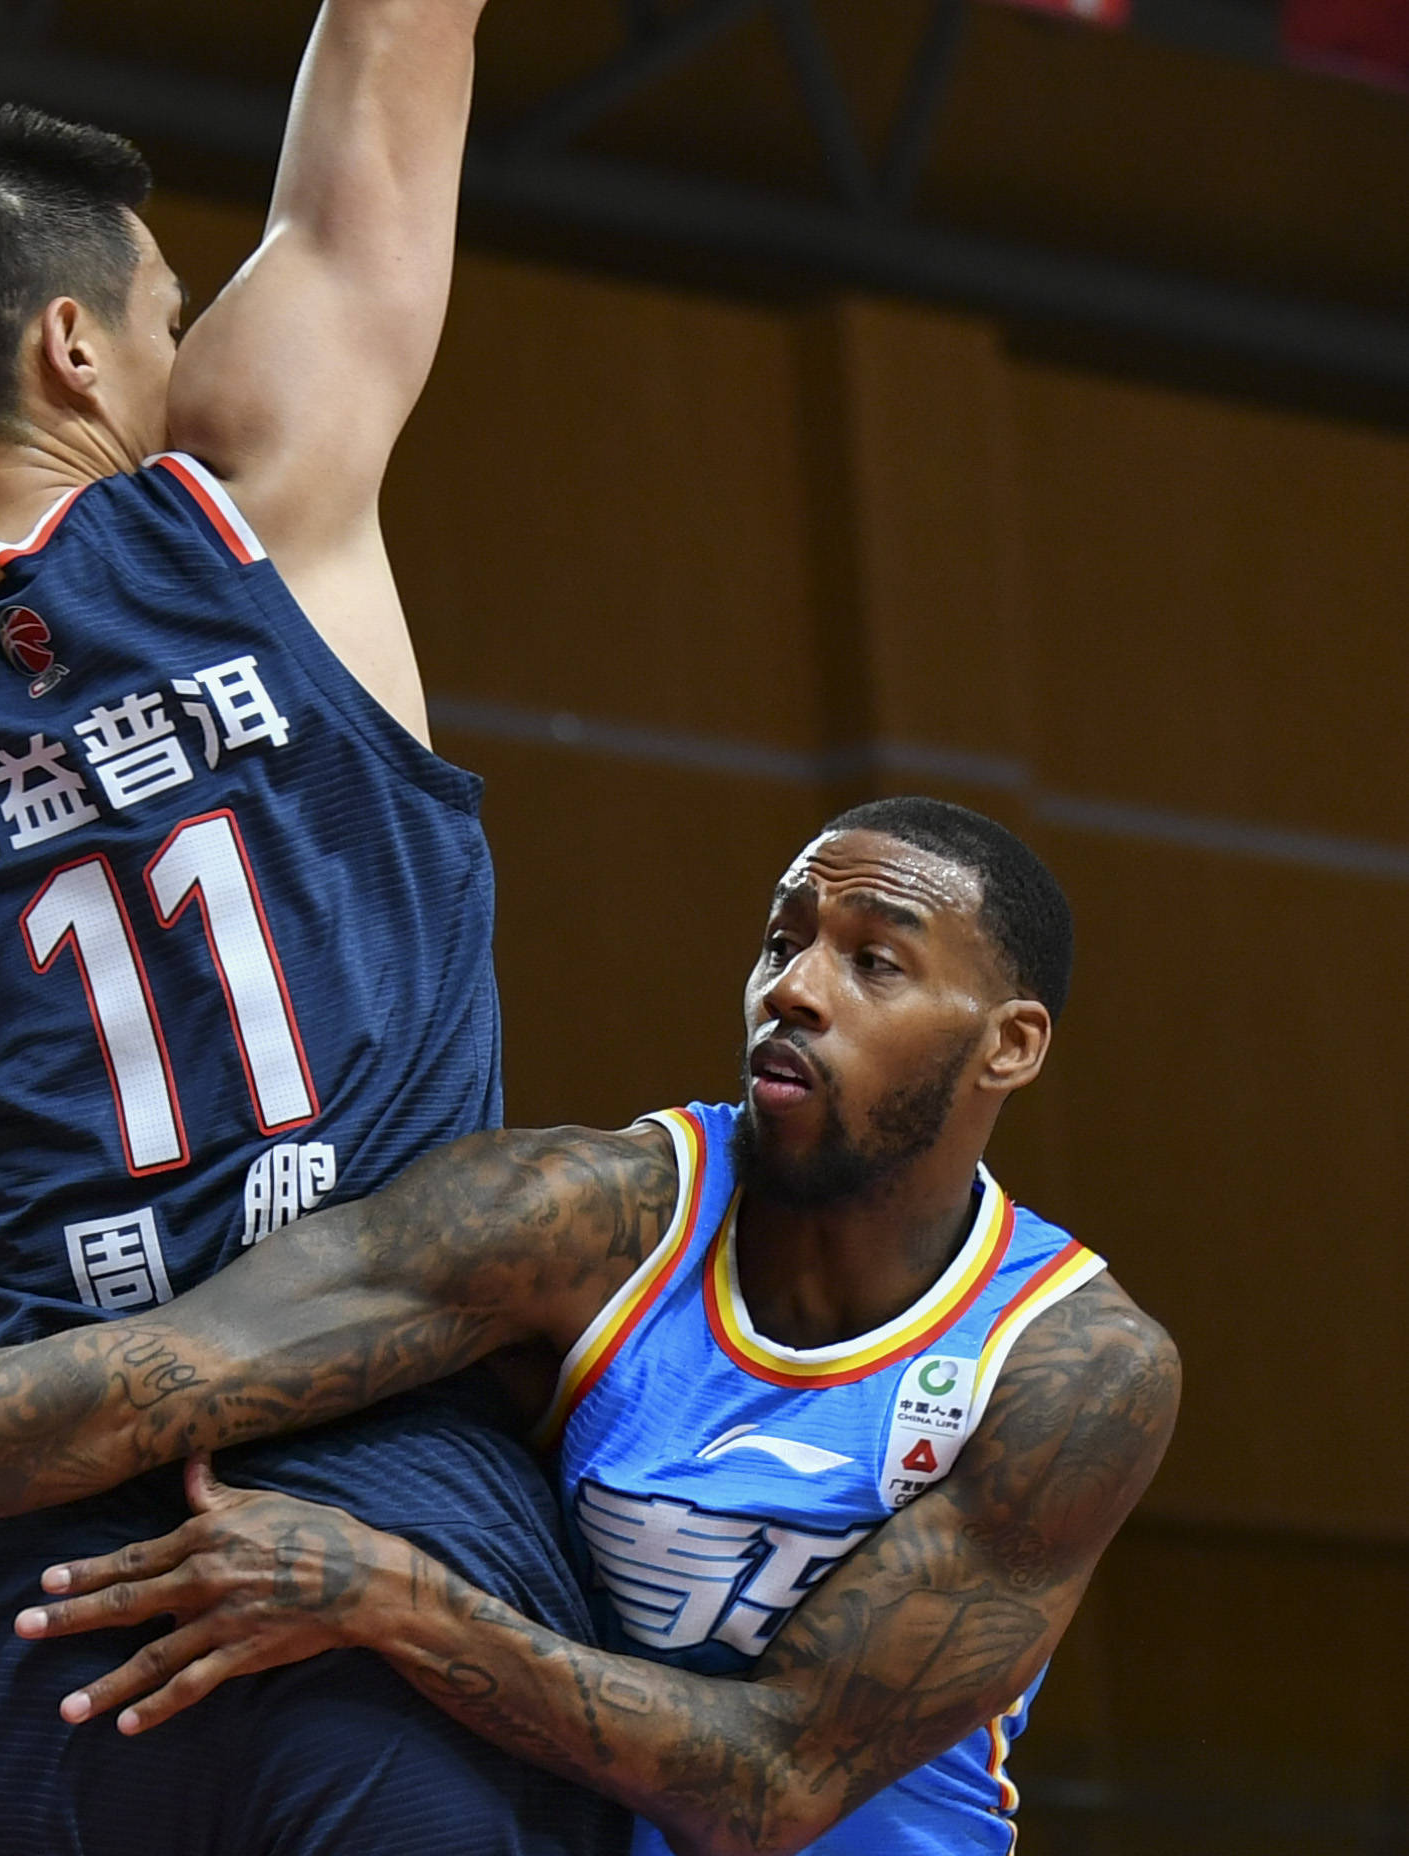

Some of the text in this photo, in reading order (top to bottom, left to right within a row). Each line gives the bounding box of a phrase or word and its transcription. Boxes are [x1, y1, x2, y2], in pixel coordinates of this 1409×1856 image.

[19, 807, 322, 1178] 11
[897, 1412, 960, 1430] CHINA LIFE
[899, 1399, 963, 1421] 中国人寿
